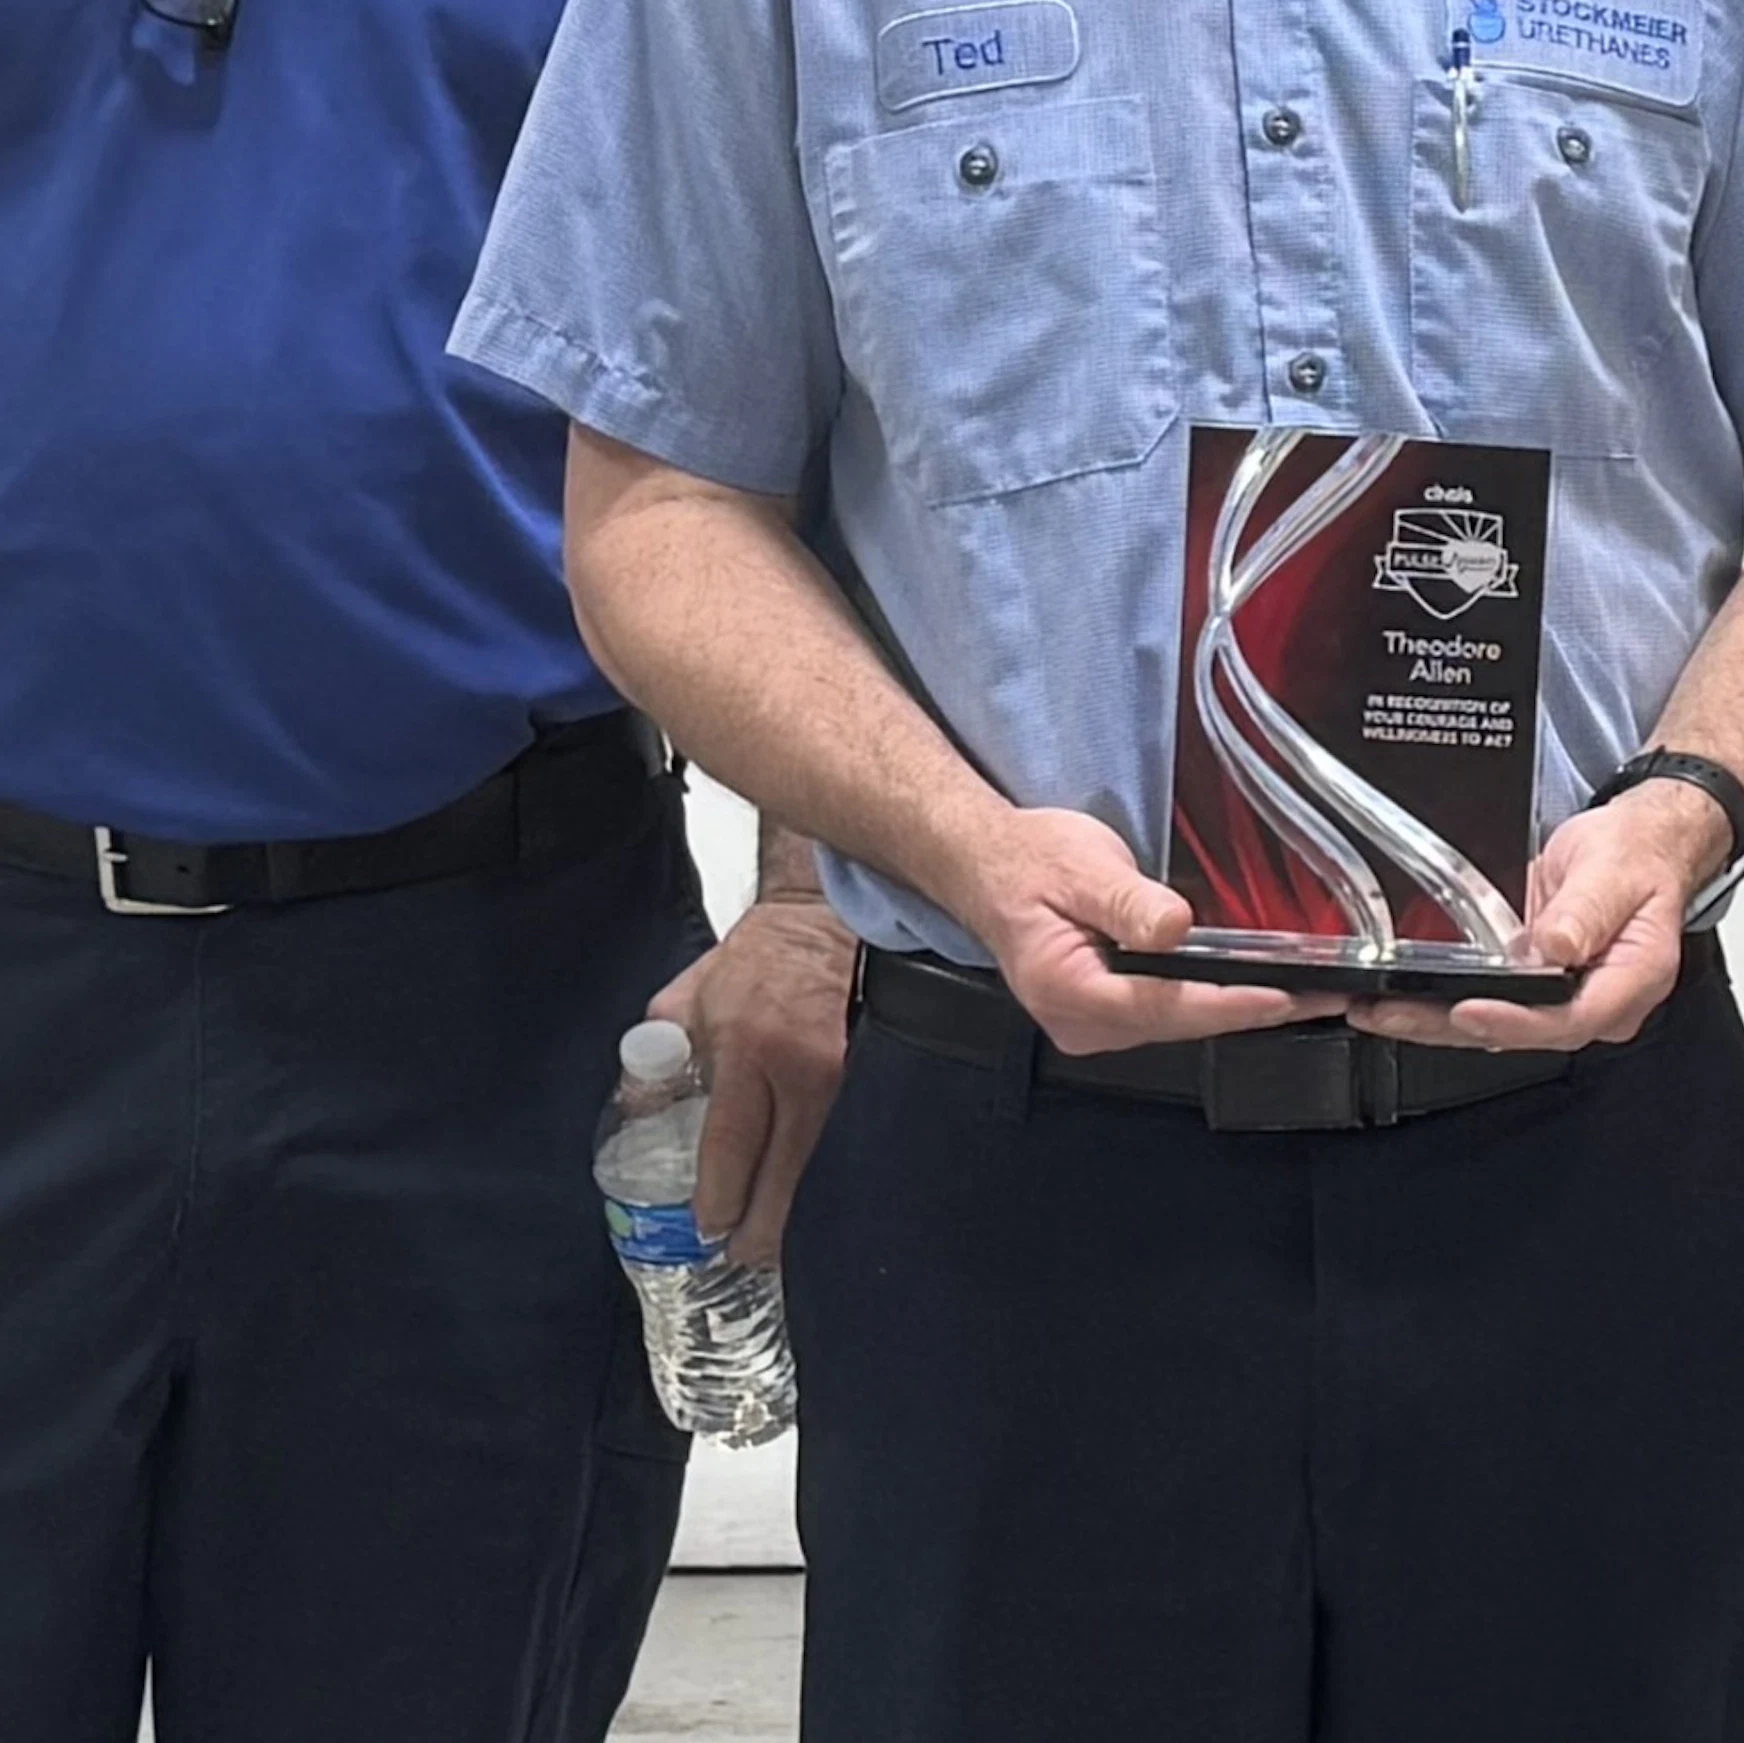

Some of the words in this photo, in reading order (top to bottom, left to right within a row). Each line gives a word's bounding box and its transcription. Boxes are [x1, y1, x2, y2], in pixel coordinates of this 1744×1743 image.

[922, 29, 1004, 76] Ted
[1518, 16, 1671, 70] URETHANES
[1382, 629, 1502, 661] Theodore
[1409, 658, 1472, 685] Allen
[1363, 710, 1404, 725] YOUR
[1406, 712, 1477, 729] COURAGE
[1480, 716, 1514, 731] AND
[1461, 732, 1482, 745] TO
[1484, 733, 1513, 748] ACT
